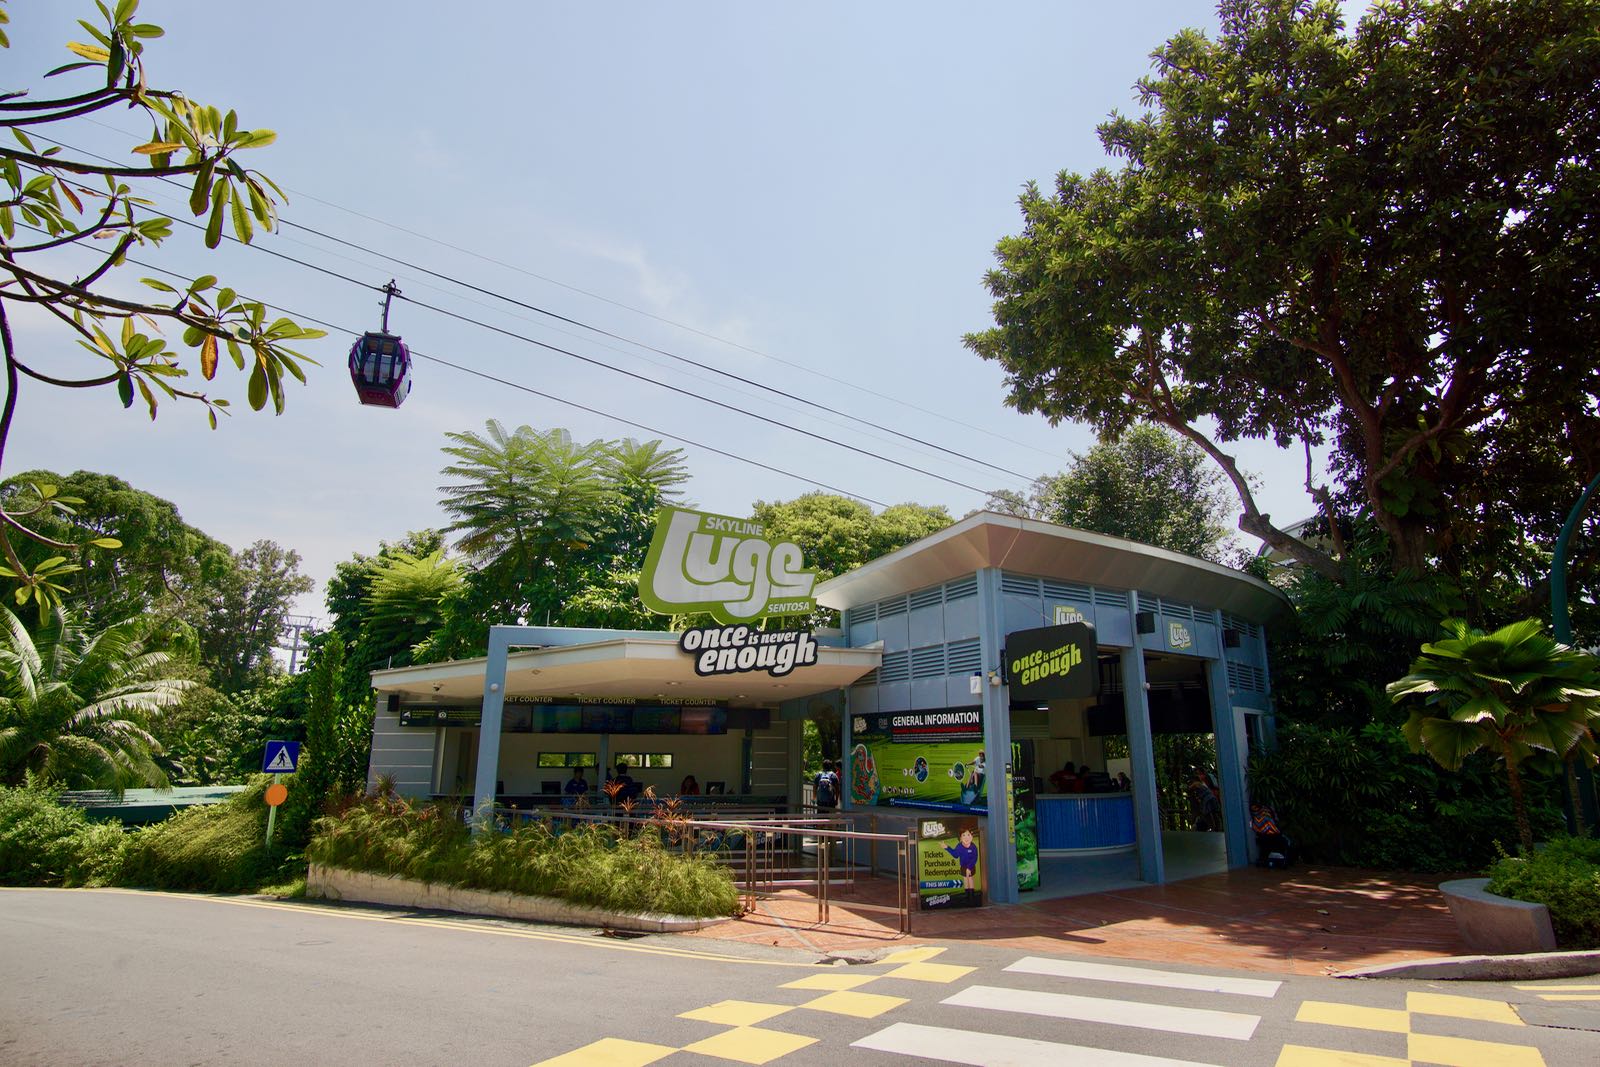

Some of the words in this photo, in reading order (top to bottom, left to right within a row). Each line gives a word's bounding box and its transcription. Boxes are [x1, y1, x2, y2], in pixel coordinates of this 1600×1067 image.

[705, 517, 763, 536] SKYLINE
[652, 511, 816, 618] Luge
[767, 602, 810, 613] SENTOSA
[683, 626, 749, 650] once
[748, 633, 758, 645] is
[760, 631, 797, 644] never
[699, 633, 815, 673] enough
[1012, 650, 1043, 674] once
[1043, 652, 1049, 661] is
[1050, 644, 1069, 658] never
[1021, 643, 1082, 686] enough
[892, 715, 923, 727] GENERAL
[924, 711, 979, 725] INFORMATION
[924, 859, 951, 867] Purchase
[924, 867, 961, 877] Redemption
